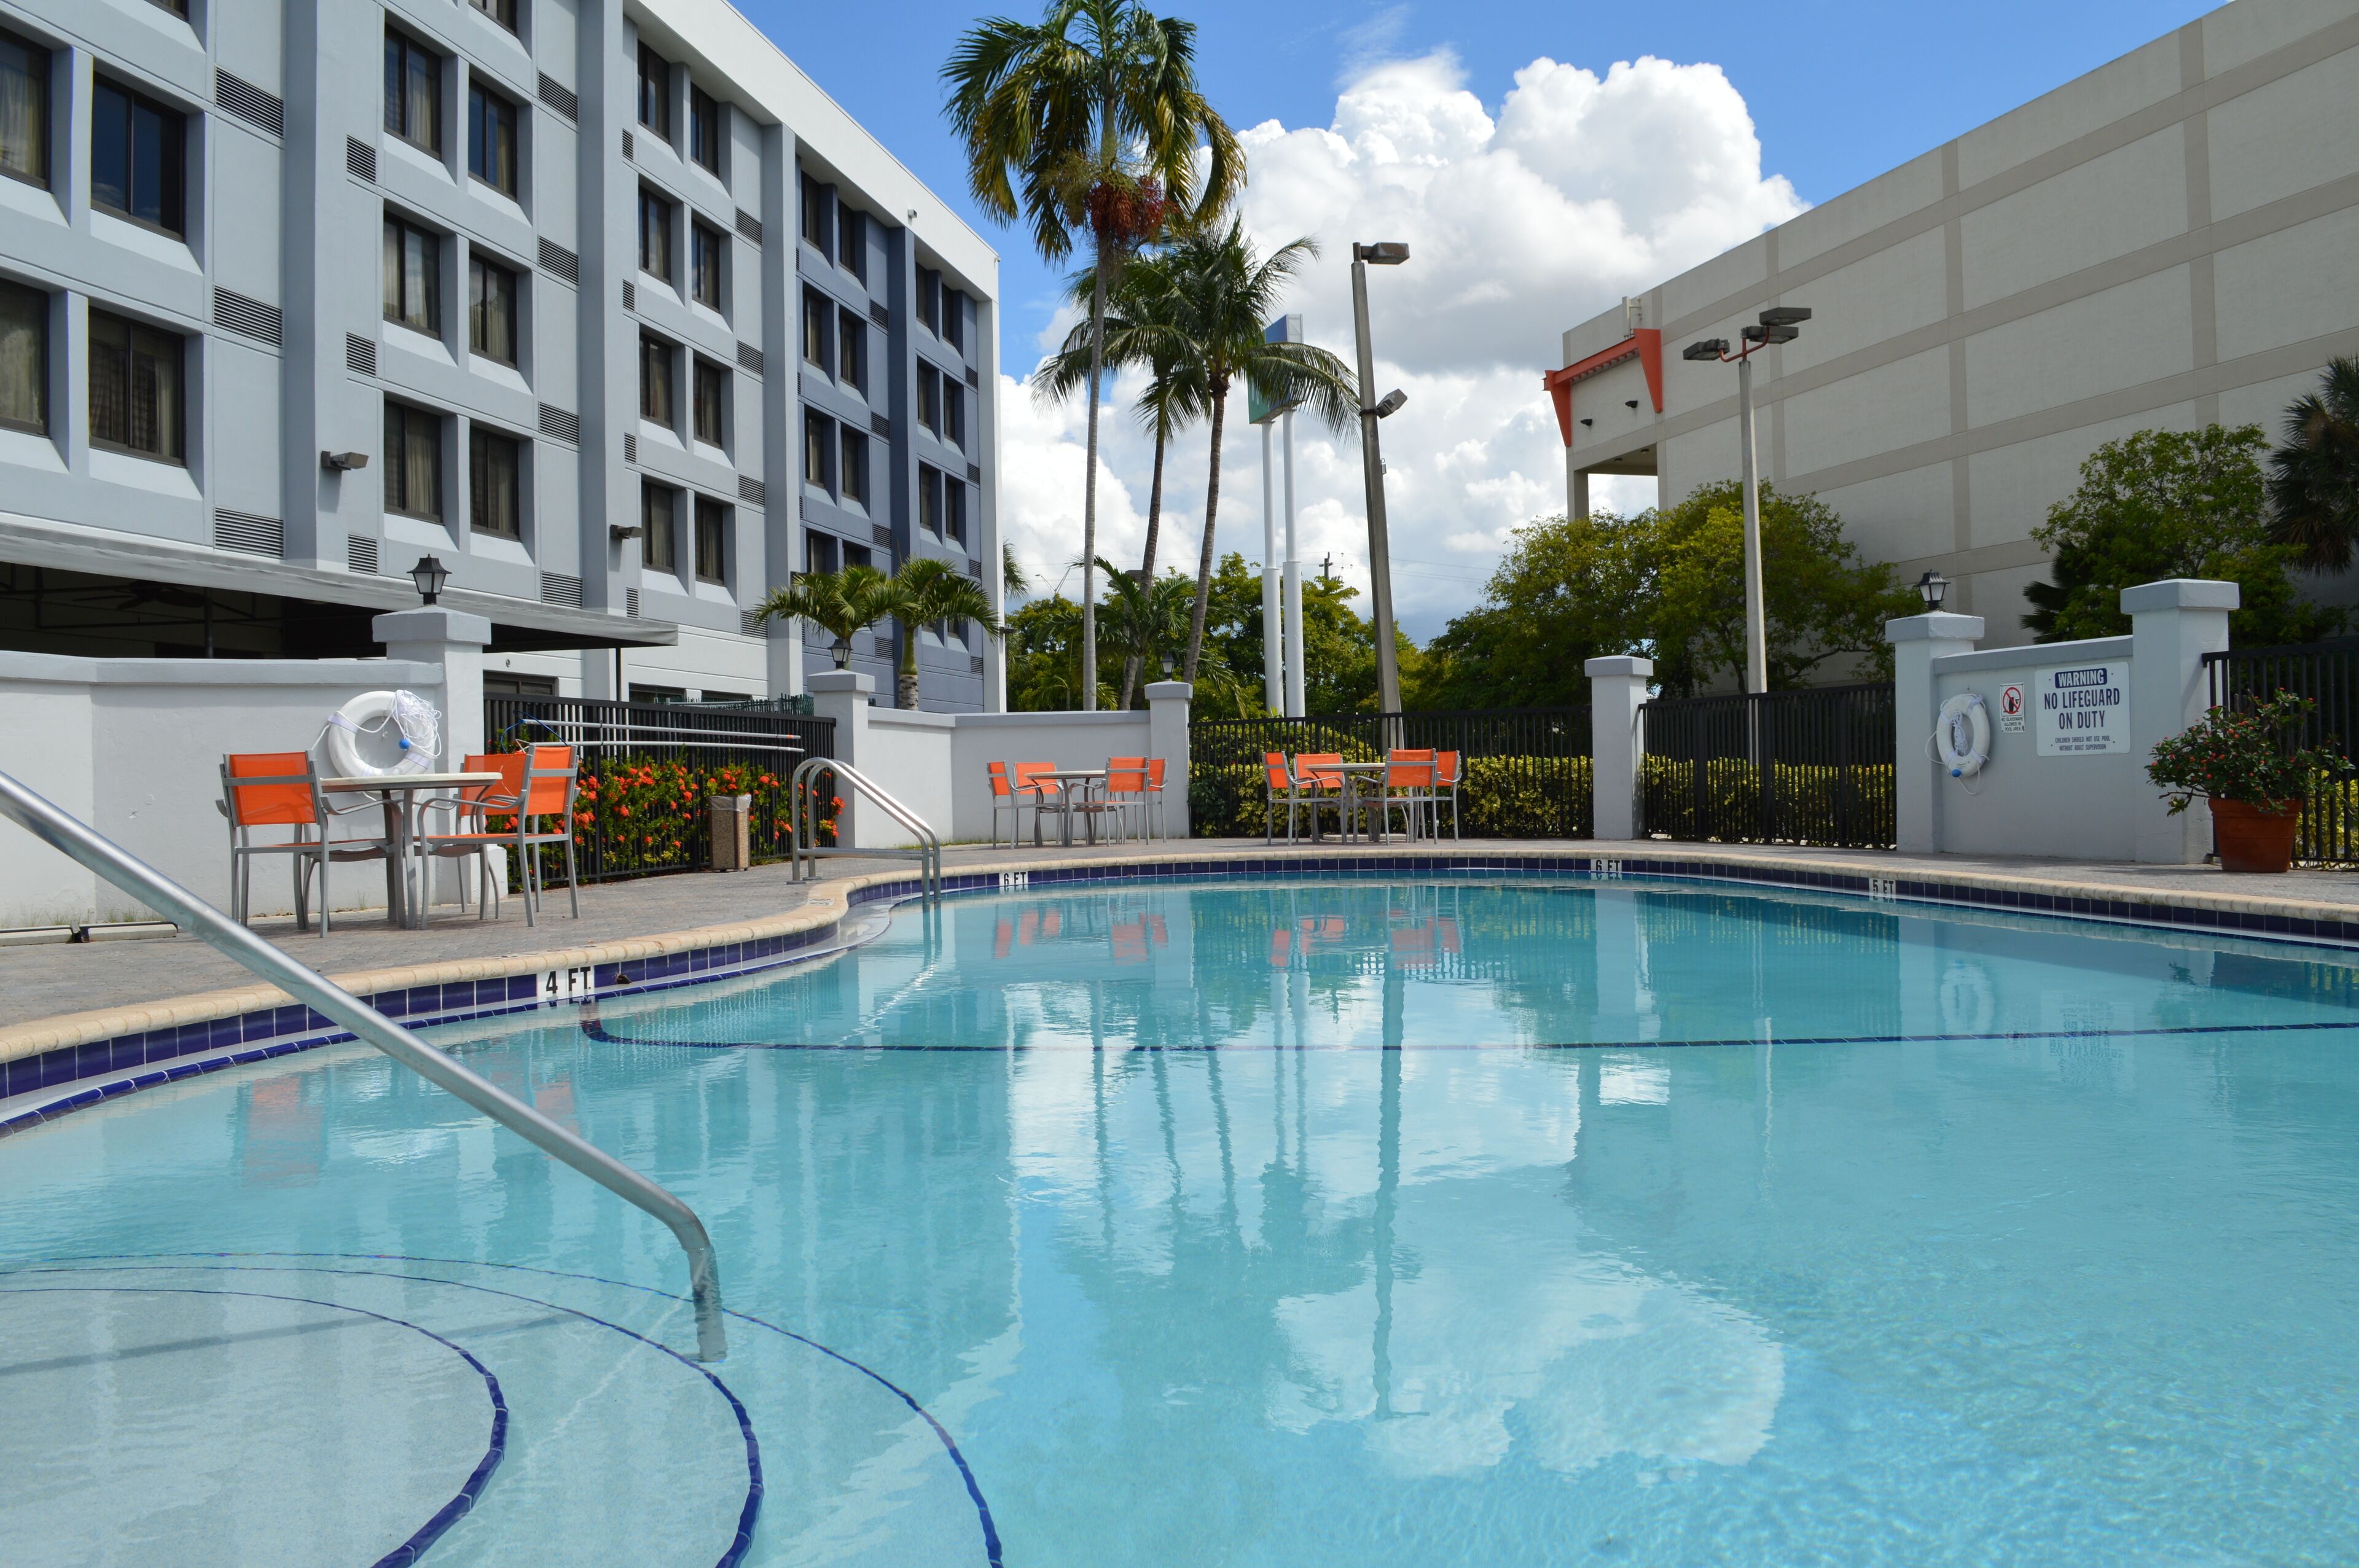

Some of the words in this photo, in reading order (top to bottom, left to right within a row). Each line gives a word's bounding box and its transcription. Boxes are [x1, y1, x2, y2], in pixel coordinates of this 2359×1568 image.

[2058, 669, 2104, 687] WARNING
[2044, 692, 2057, 710] NO
[2062, 688, 2120, 709] LIFEGUARD
[2059, 712, 2073, 730] ON
[2077, 710, 2105, 729] DUTY
[1595, 859, 1602, 873] 6
[1608, 860, 1620, 872] FT
[1004, 873, 1009, 886] 6
[1014, 872, 1026, 886] FT
[1872, 879, 1879, 894] 5
[1883, 880, 1894, 894] FT
[546, 970, 558, 994] 4
